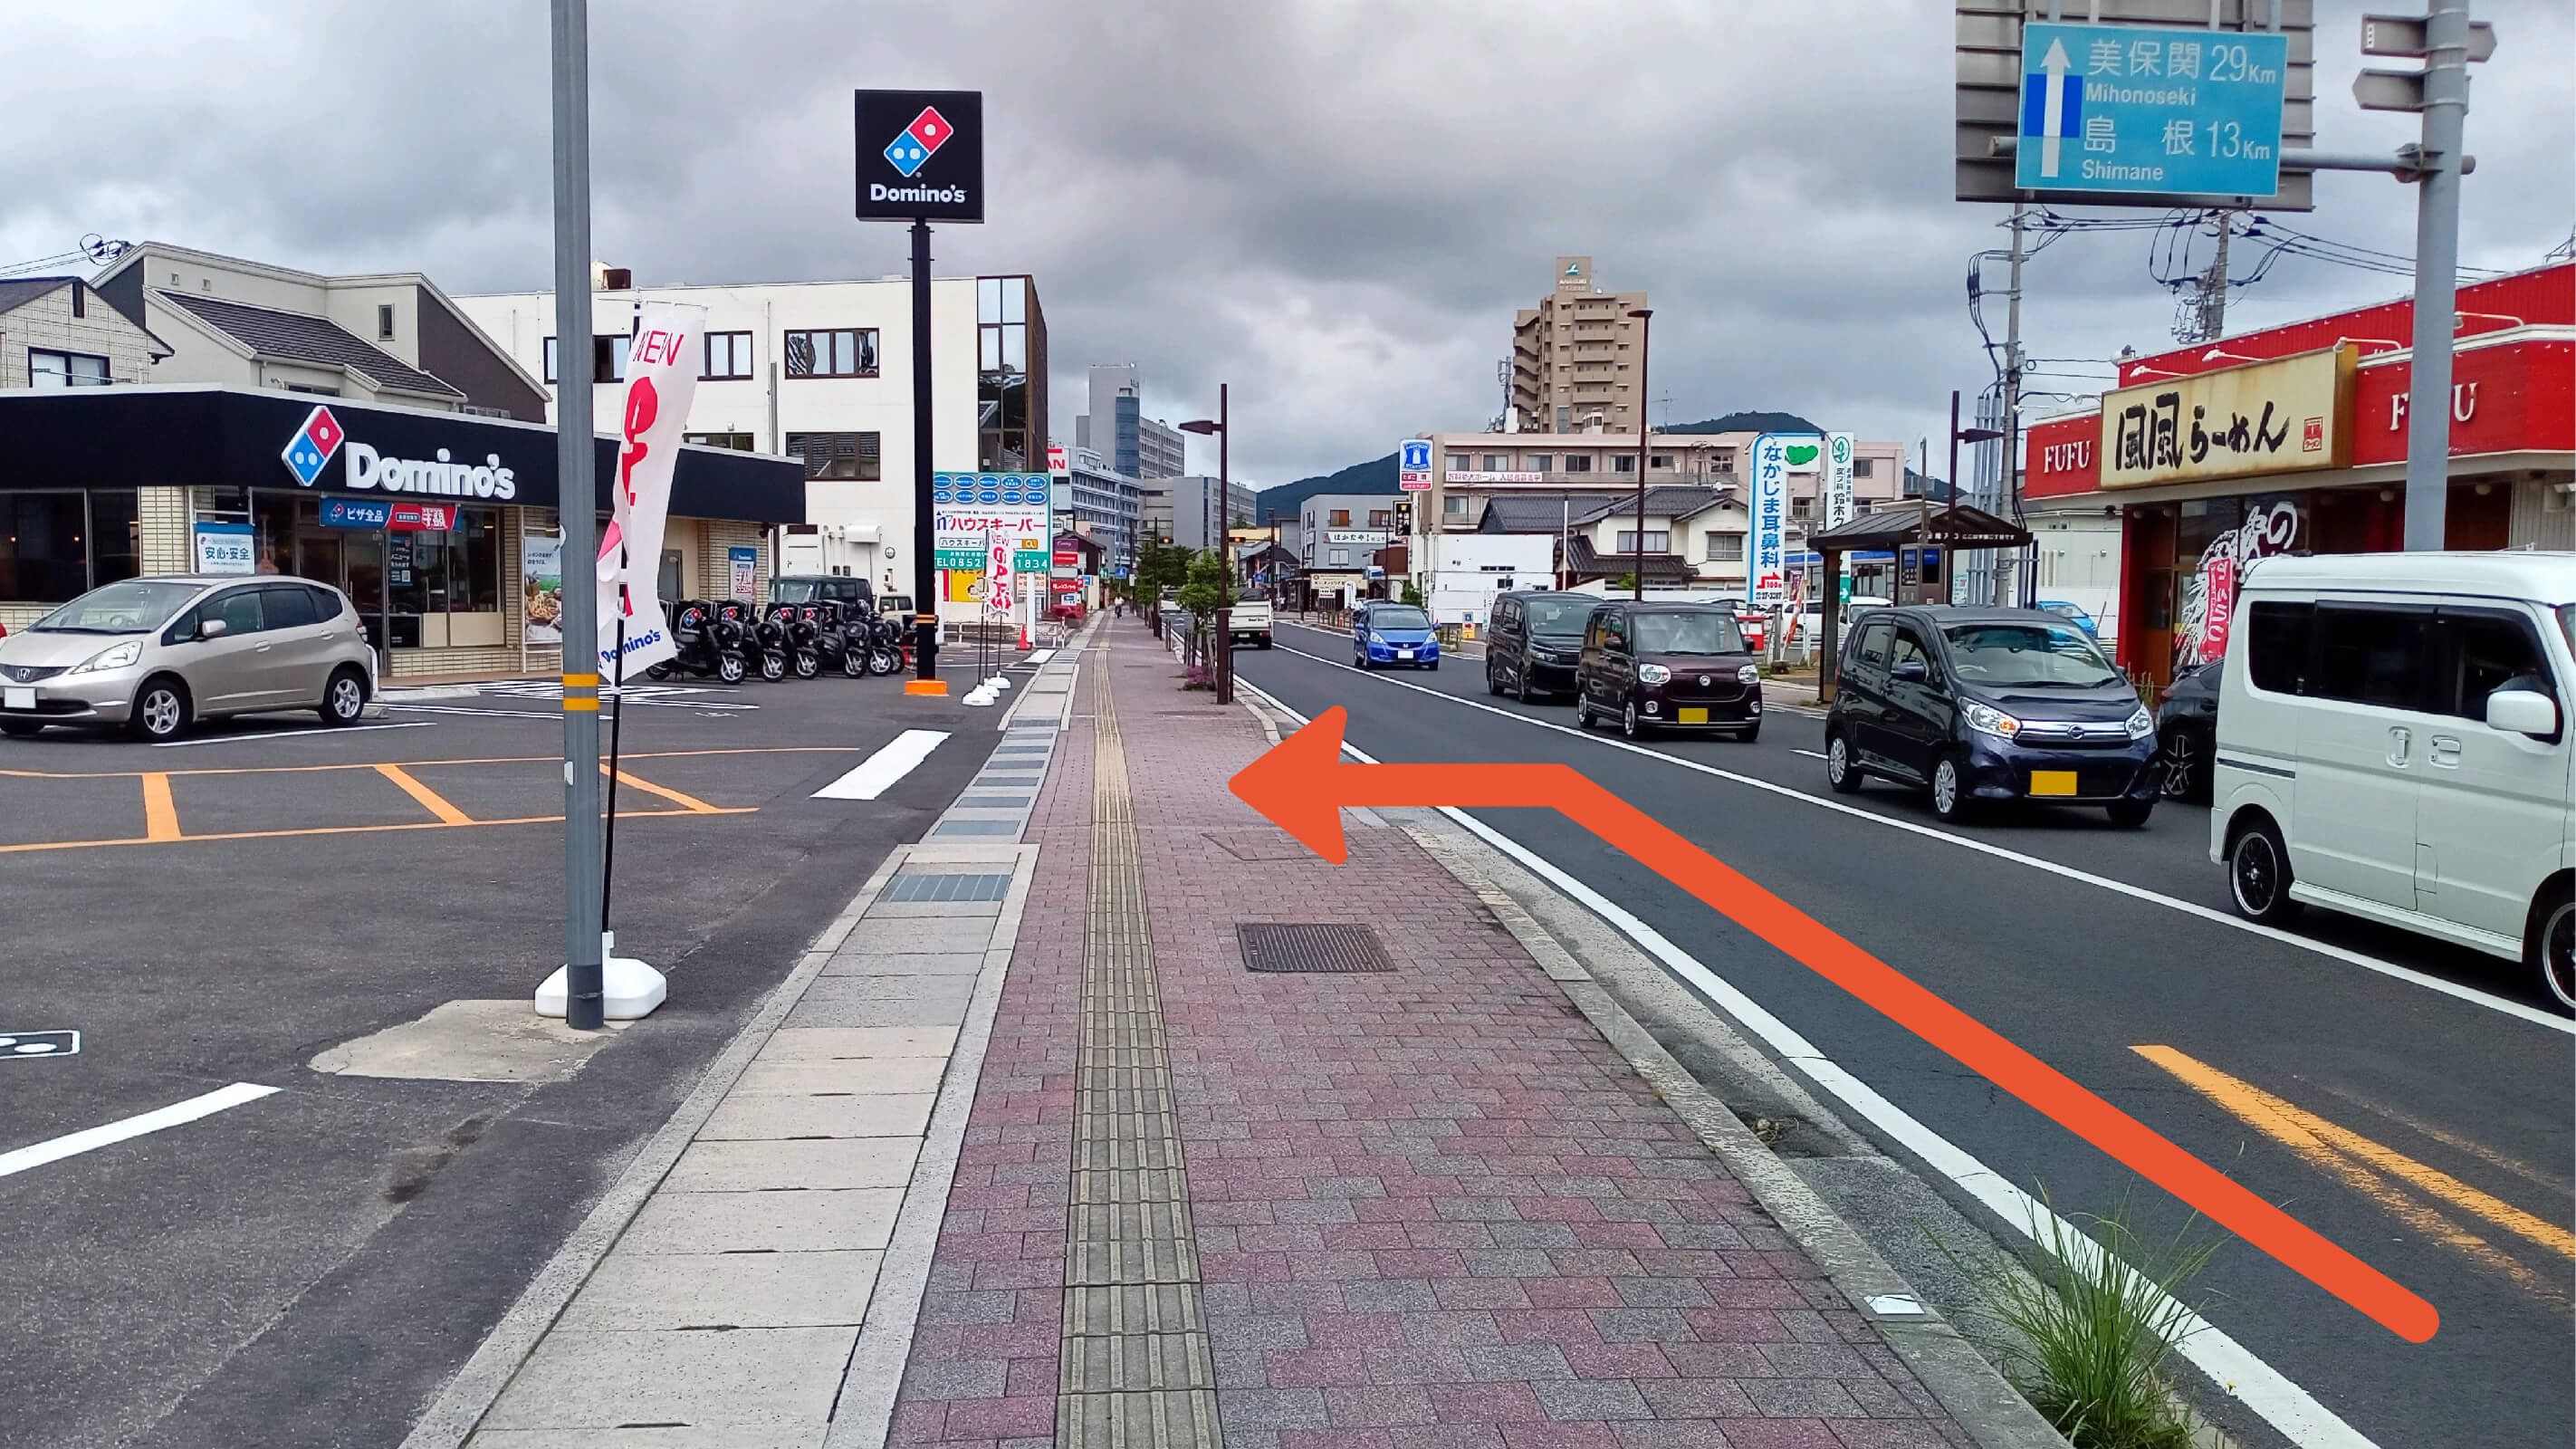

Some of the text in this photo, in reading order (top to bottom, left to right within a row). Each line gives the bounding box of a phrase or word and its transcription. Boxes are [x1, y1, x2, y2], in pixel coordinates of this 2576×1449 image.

[2087, 39, 2201, 80] 美保関
[2085, 82, 2196, 106] Mihonoseki
[2082, 159, 2164, 181] Shimane
[870, 183, 965, 203] Domino's
[2044, 440, 2091, 474] FUFU
[345, 441, 515, 499] Domino's
[347, 507, 384, 523] ピザ全品
[1760, 446, 1783, 568] なかじま耳鼻科
[206, 547, 251, 560] 安心・安全
